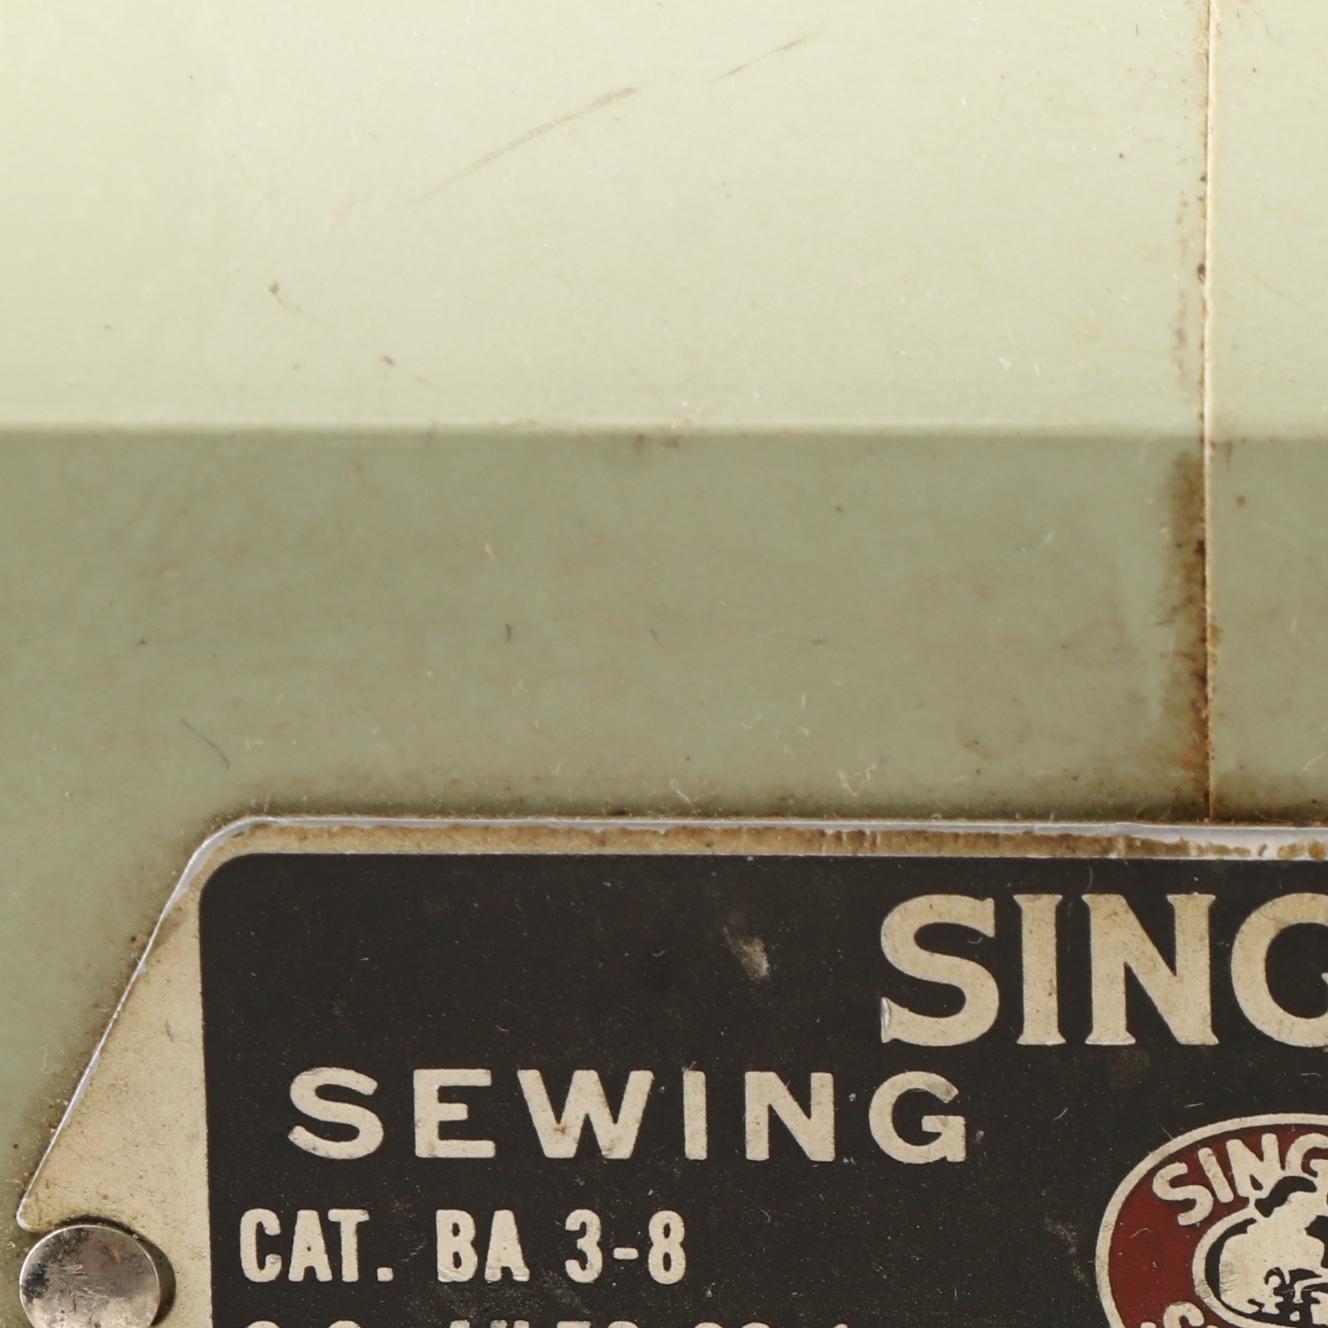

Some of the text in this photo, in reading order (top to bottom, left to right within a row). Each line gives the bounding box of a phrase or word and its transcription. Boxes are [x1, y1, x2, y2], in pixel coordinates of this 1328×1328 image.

[288, 1066, 968, 1167] SEWING
[239, 1208, 687, 1285] CAT. BA 3-8
